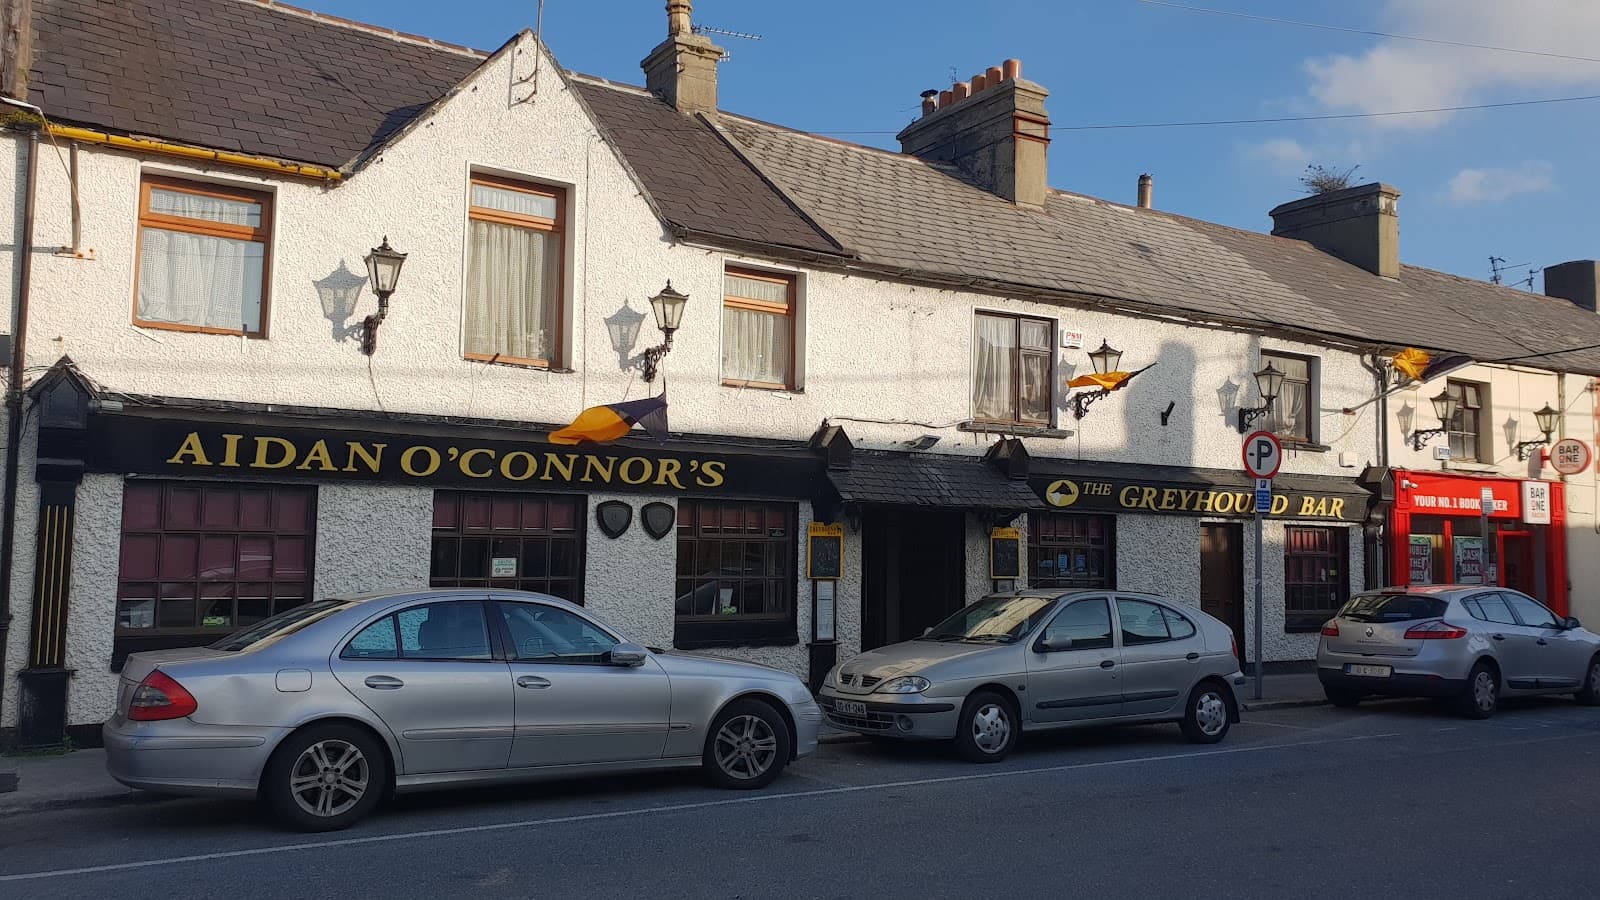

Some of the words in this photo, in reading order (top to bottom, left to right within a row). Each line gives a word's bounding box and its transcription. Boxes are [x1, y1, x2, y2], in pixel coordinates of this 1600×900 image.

[1256, 439, 1273, 470] P
[1559, 445, 1580, 454] BAR
[166, 431, 388, 474] AIDAN
[400, 445, 727, 490] O'CONNOR'S
[1559, 454, 1580, 463] ONE
[1530, 487, 1545, 499] BAR
[1083, 482, 1113, 496] THE
[1119, 485, 1289, 515] GREYHOUD
[1298, 495, 1345, 520] BAR
[1414, 495, 1436, 507] YOUR
[1459, 497, 1508, 512] BOOKKER
[1531, 500, 1545, 511] ONE
[1463, 549, 1480, 561] CASH
[1462, 563, 1480, 574] BACK
